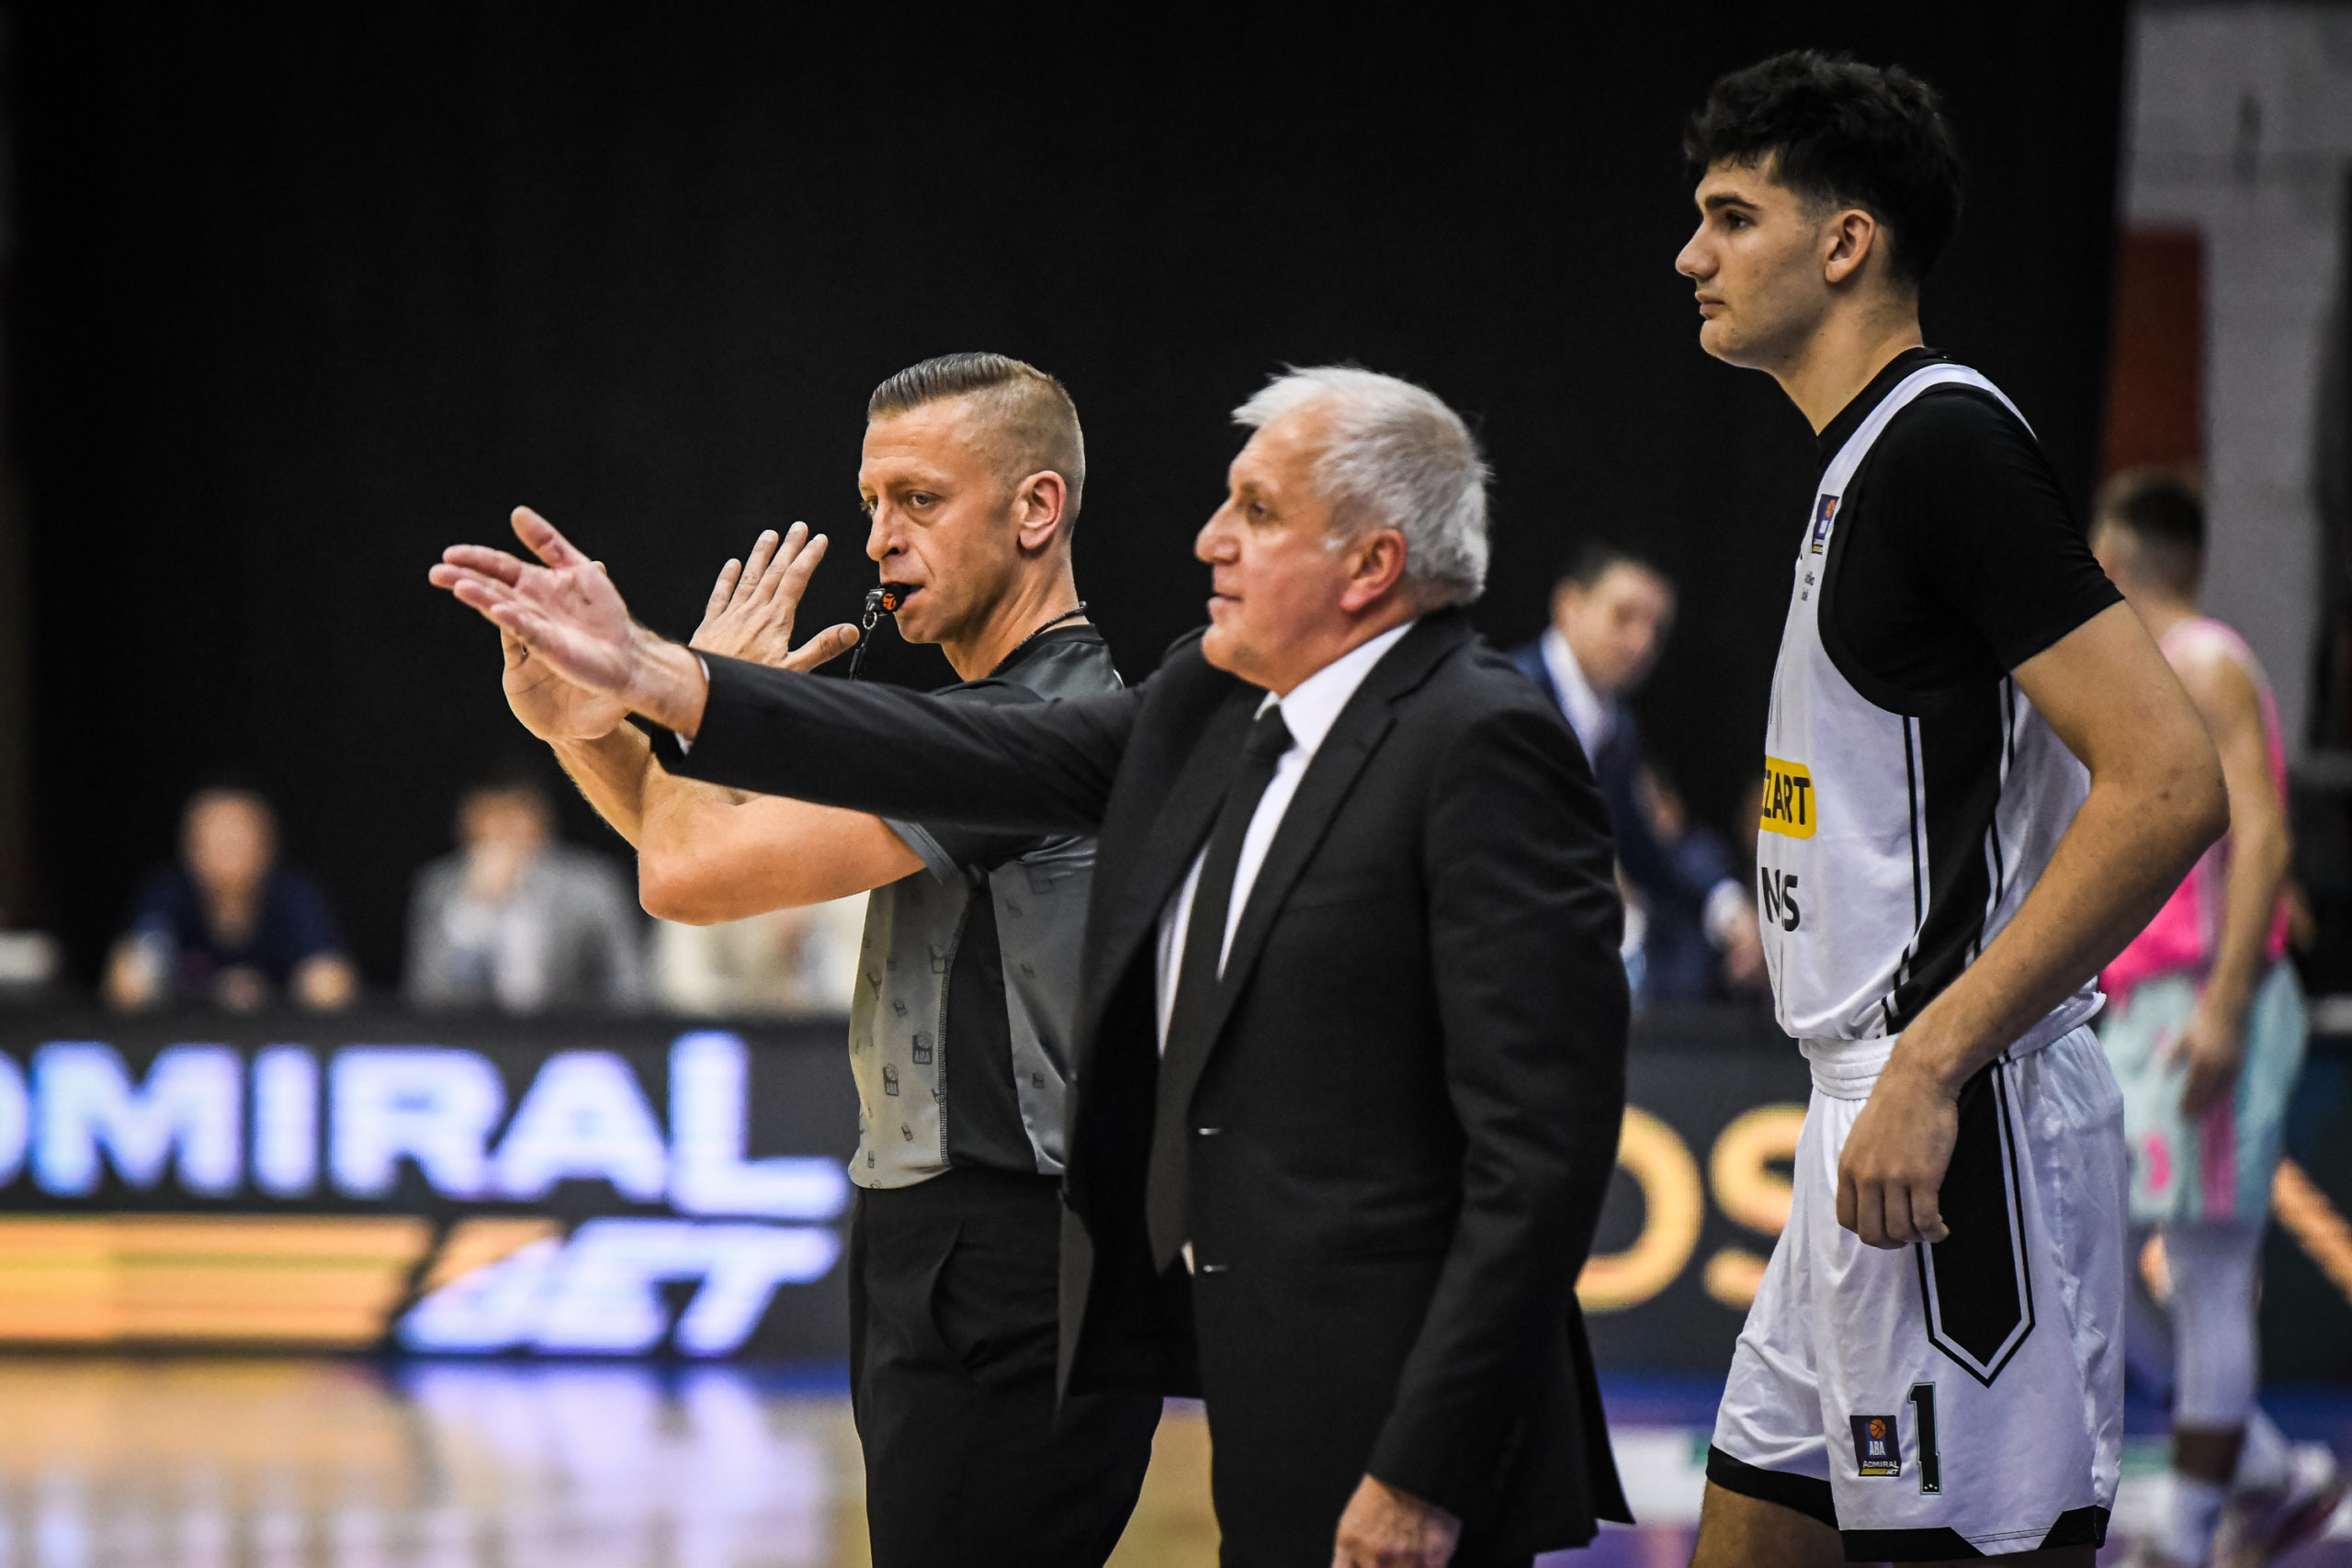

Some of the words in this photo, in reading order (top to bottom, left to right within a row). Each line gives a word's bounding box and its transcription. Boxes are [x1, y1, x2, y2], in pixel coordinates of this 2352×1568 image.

[1761, 769, 1811, 826] ZART
[0, 1031, 849, 1222] MIRAL
[1862, 1460, 1899, 1469] ADMIRAL
[1869, 1440, 1886, 1456] ABA
[1906, 1382, 1942, 1495] 1
